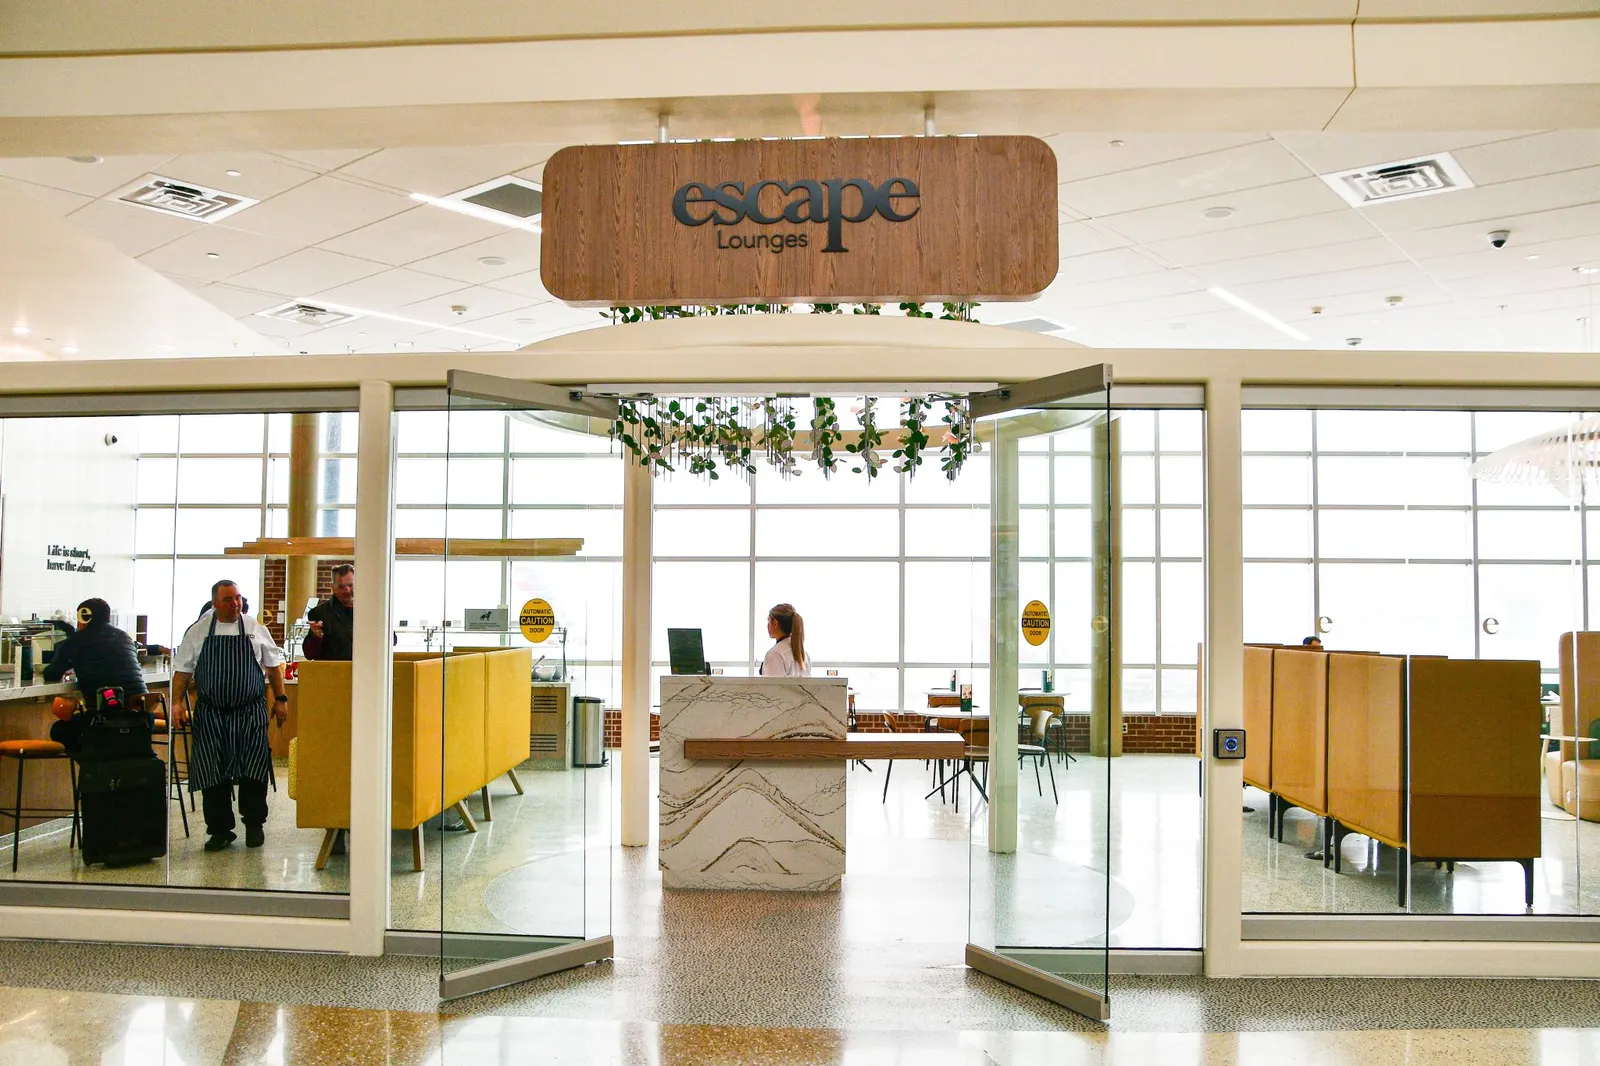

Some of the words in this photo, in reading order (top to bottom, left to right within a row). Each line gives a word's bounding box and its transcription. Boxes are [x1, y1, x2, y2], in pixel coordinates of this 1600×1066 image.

[672, 177, 920, 253] escape
[717, 230, 808, 253] Lounges
[47, 545, 62, 556] Life
[63, 545, 70, 557] is
[47, 559, 64, 571] have
[65, 560, 76, 571] the
[1022, 619, 1049, 627] CAUTION
